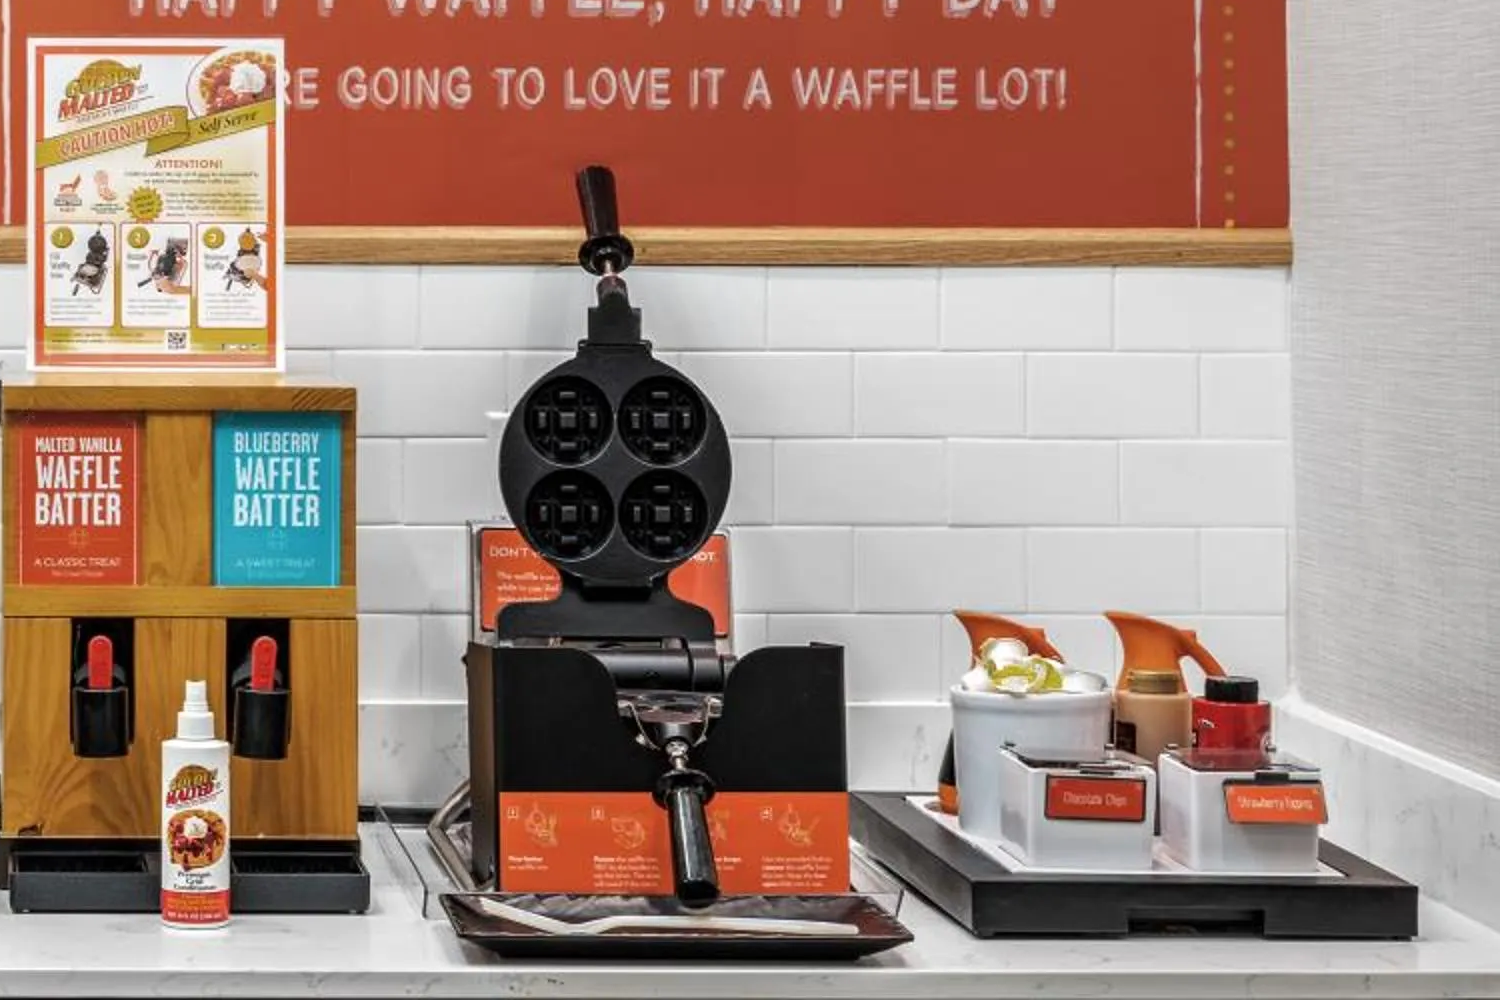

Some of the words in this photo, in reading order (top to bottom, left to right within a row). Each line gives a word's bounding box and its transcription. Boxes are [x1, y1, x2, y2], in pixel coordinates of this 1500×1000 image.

[337, 66, 472, 110] GOING
[491, 66, 545, 110] TO
[563, 66, 672, 110] LOVE
[689, 66, 725, 110] IT
[744, 66, 773, 110] A
[792, 66, 959, 110] WAFFLE
[976, 66, 1068, 110] LOT!
[60, 122, 132, 157] CAUTION
[198, 117, 222, 135] Self
[223, 110, 258, 128] Serve
[154, 159, 223, 169] ATTENTION!
[35, 436, 75, 453] MALTED
[79, 436, 123, 453] VANILLA
[234, 431, 320, 454] BLUEBERRY
[35, 455, 123, 489] WAFFLE
[235, 456, 321, 490] WAFFLE
[35, 491, 122, 526] BATTER
[233, 493, 321, 527] BATTER
